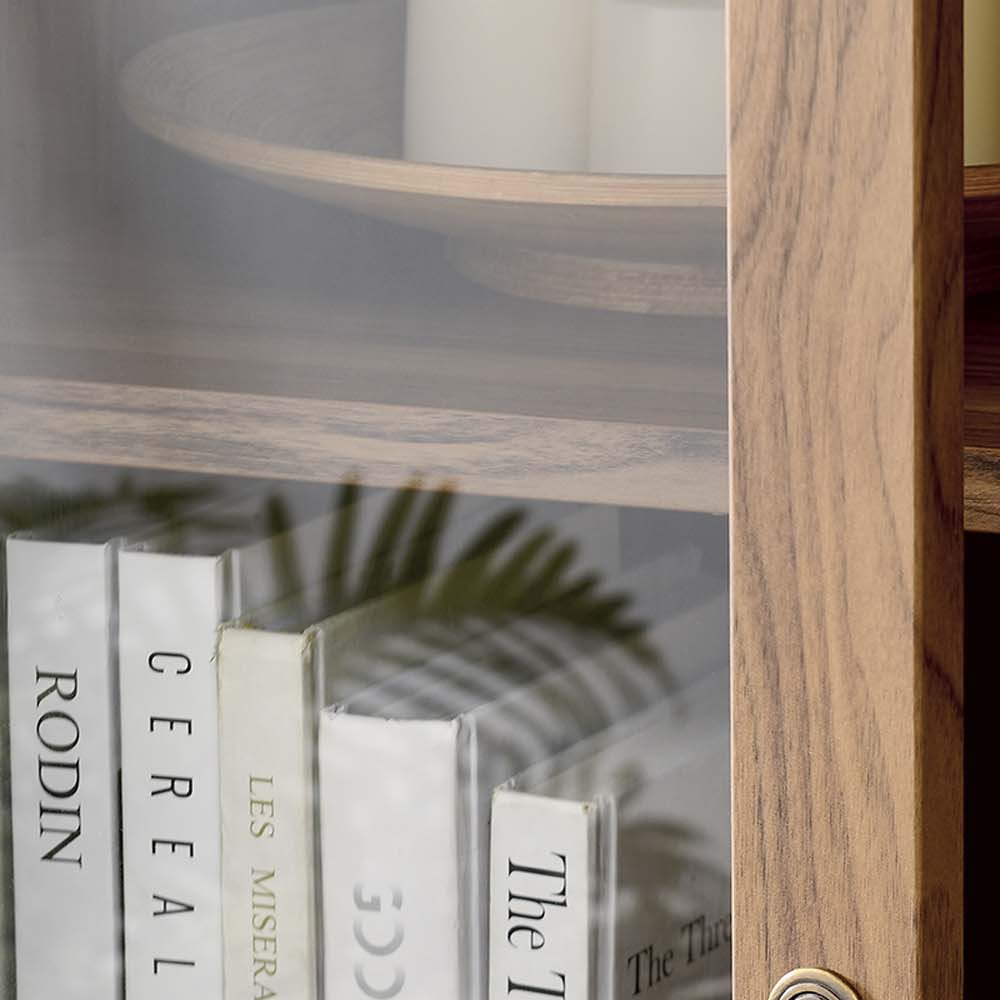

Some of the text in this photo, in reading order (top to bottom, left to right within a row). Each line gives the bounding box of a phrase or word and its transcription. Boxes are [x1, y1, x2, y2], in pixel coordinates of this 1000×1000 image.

[35, 665, 83, 869] RODIN
[147, 650, 196, 976] CEREAL
[248, 774, 275, 840] LES
[506, 852, 568, 951] The
[627, 943, 674, 997] The
